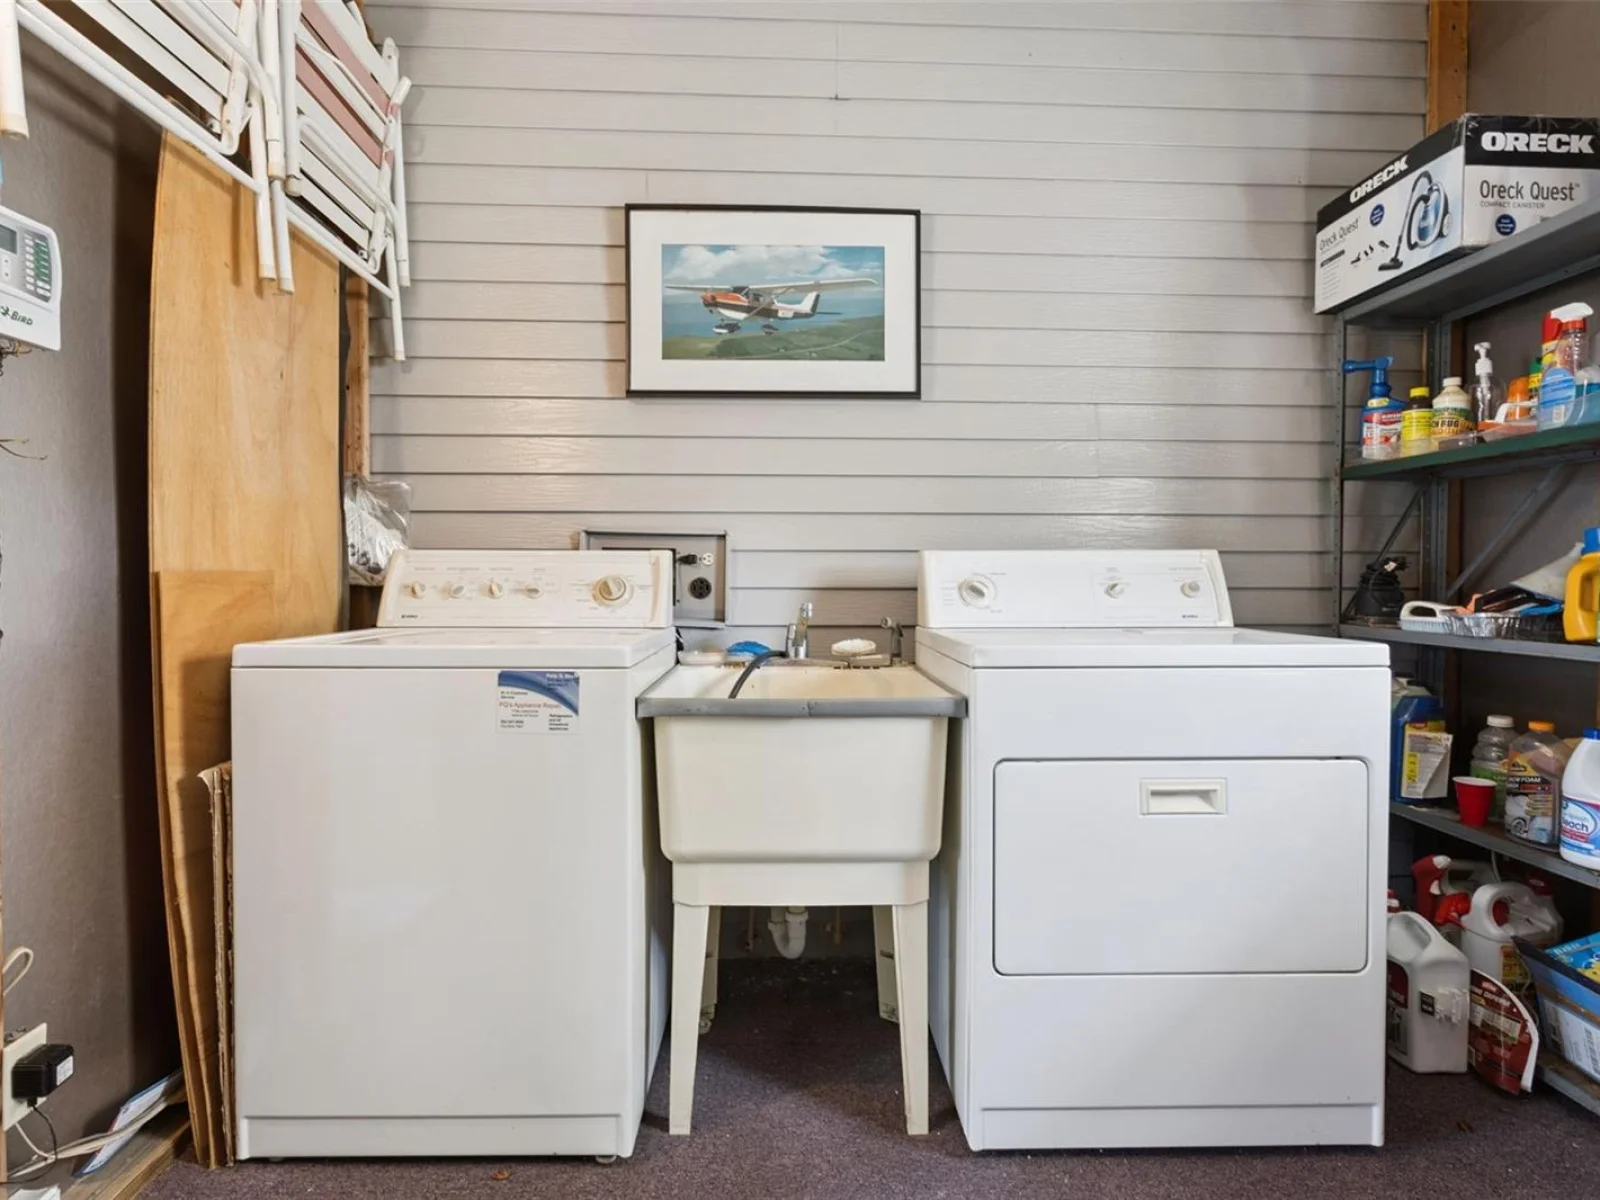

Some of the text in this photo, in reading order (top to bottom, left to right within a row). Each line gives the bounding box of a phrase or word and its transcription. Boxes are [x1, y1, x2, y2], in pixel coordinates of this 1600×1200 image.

[1481, 131, 1595, 154] ORECK
[1349, 154, 1410, 204] ORECK
[1480, 180, 1525, 200] Oreck
